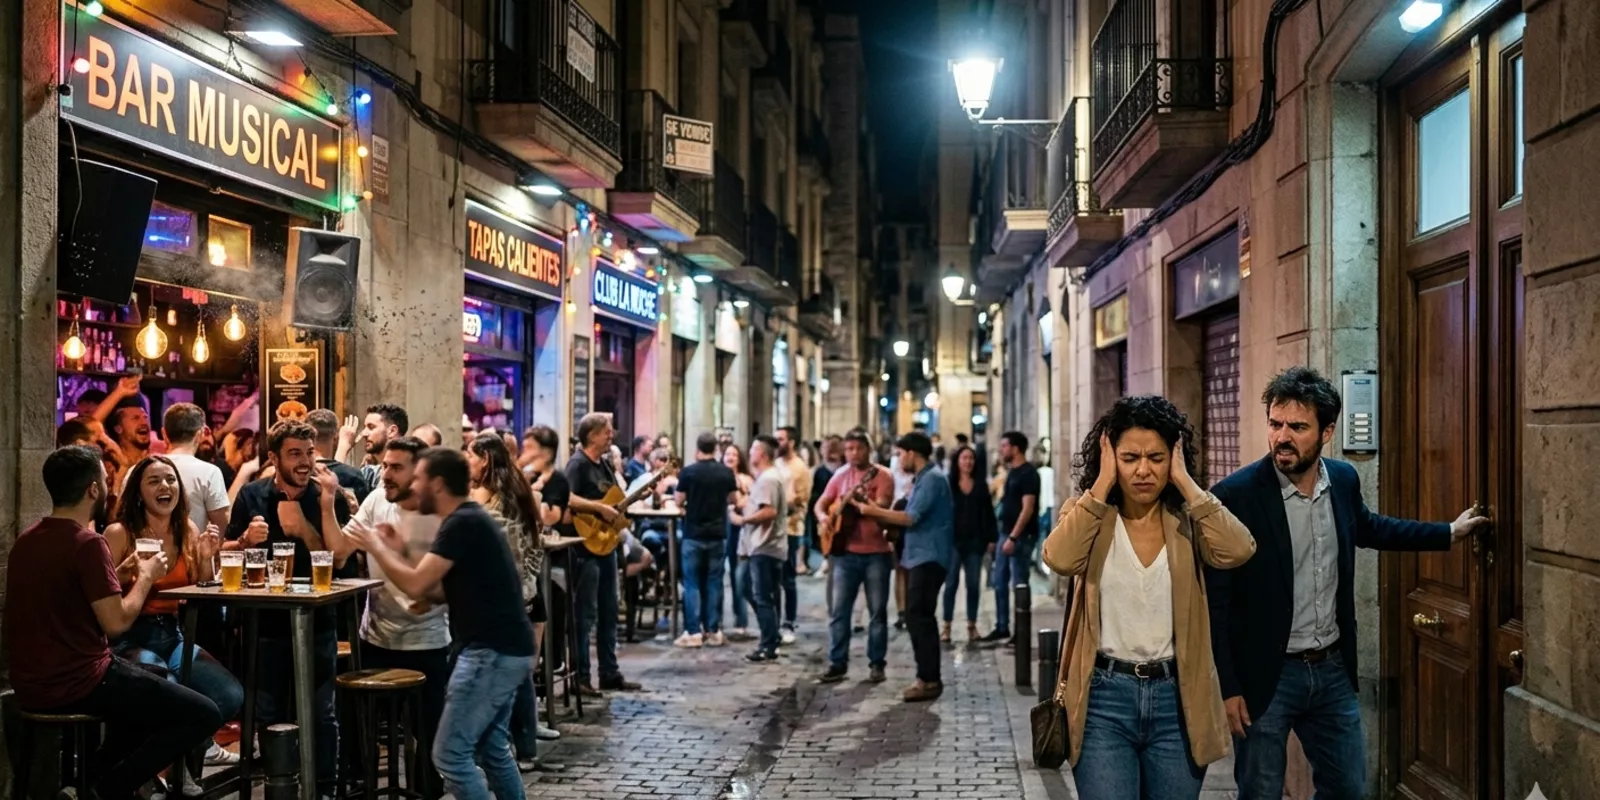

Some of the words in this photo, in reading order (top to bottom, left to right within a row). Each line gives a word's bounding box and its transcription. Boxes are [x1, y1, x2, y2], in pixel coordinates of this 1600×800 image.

[88, 36, 176, 134] BAR
[188, 79, 326, 190] MUSICAL
[666, 119, 679, 136] SE
[468, 219, 506, 269] TAPAS
[594, 269, 619, 308] CLUB
[618, 280, 630, 312] LA
